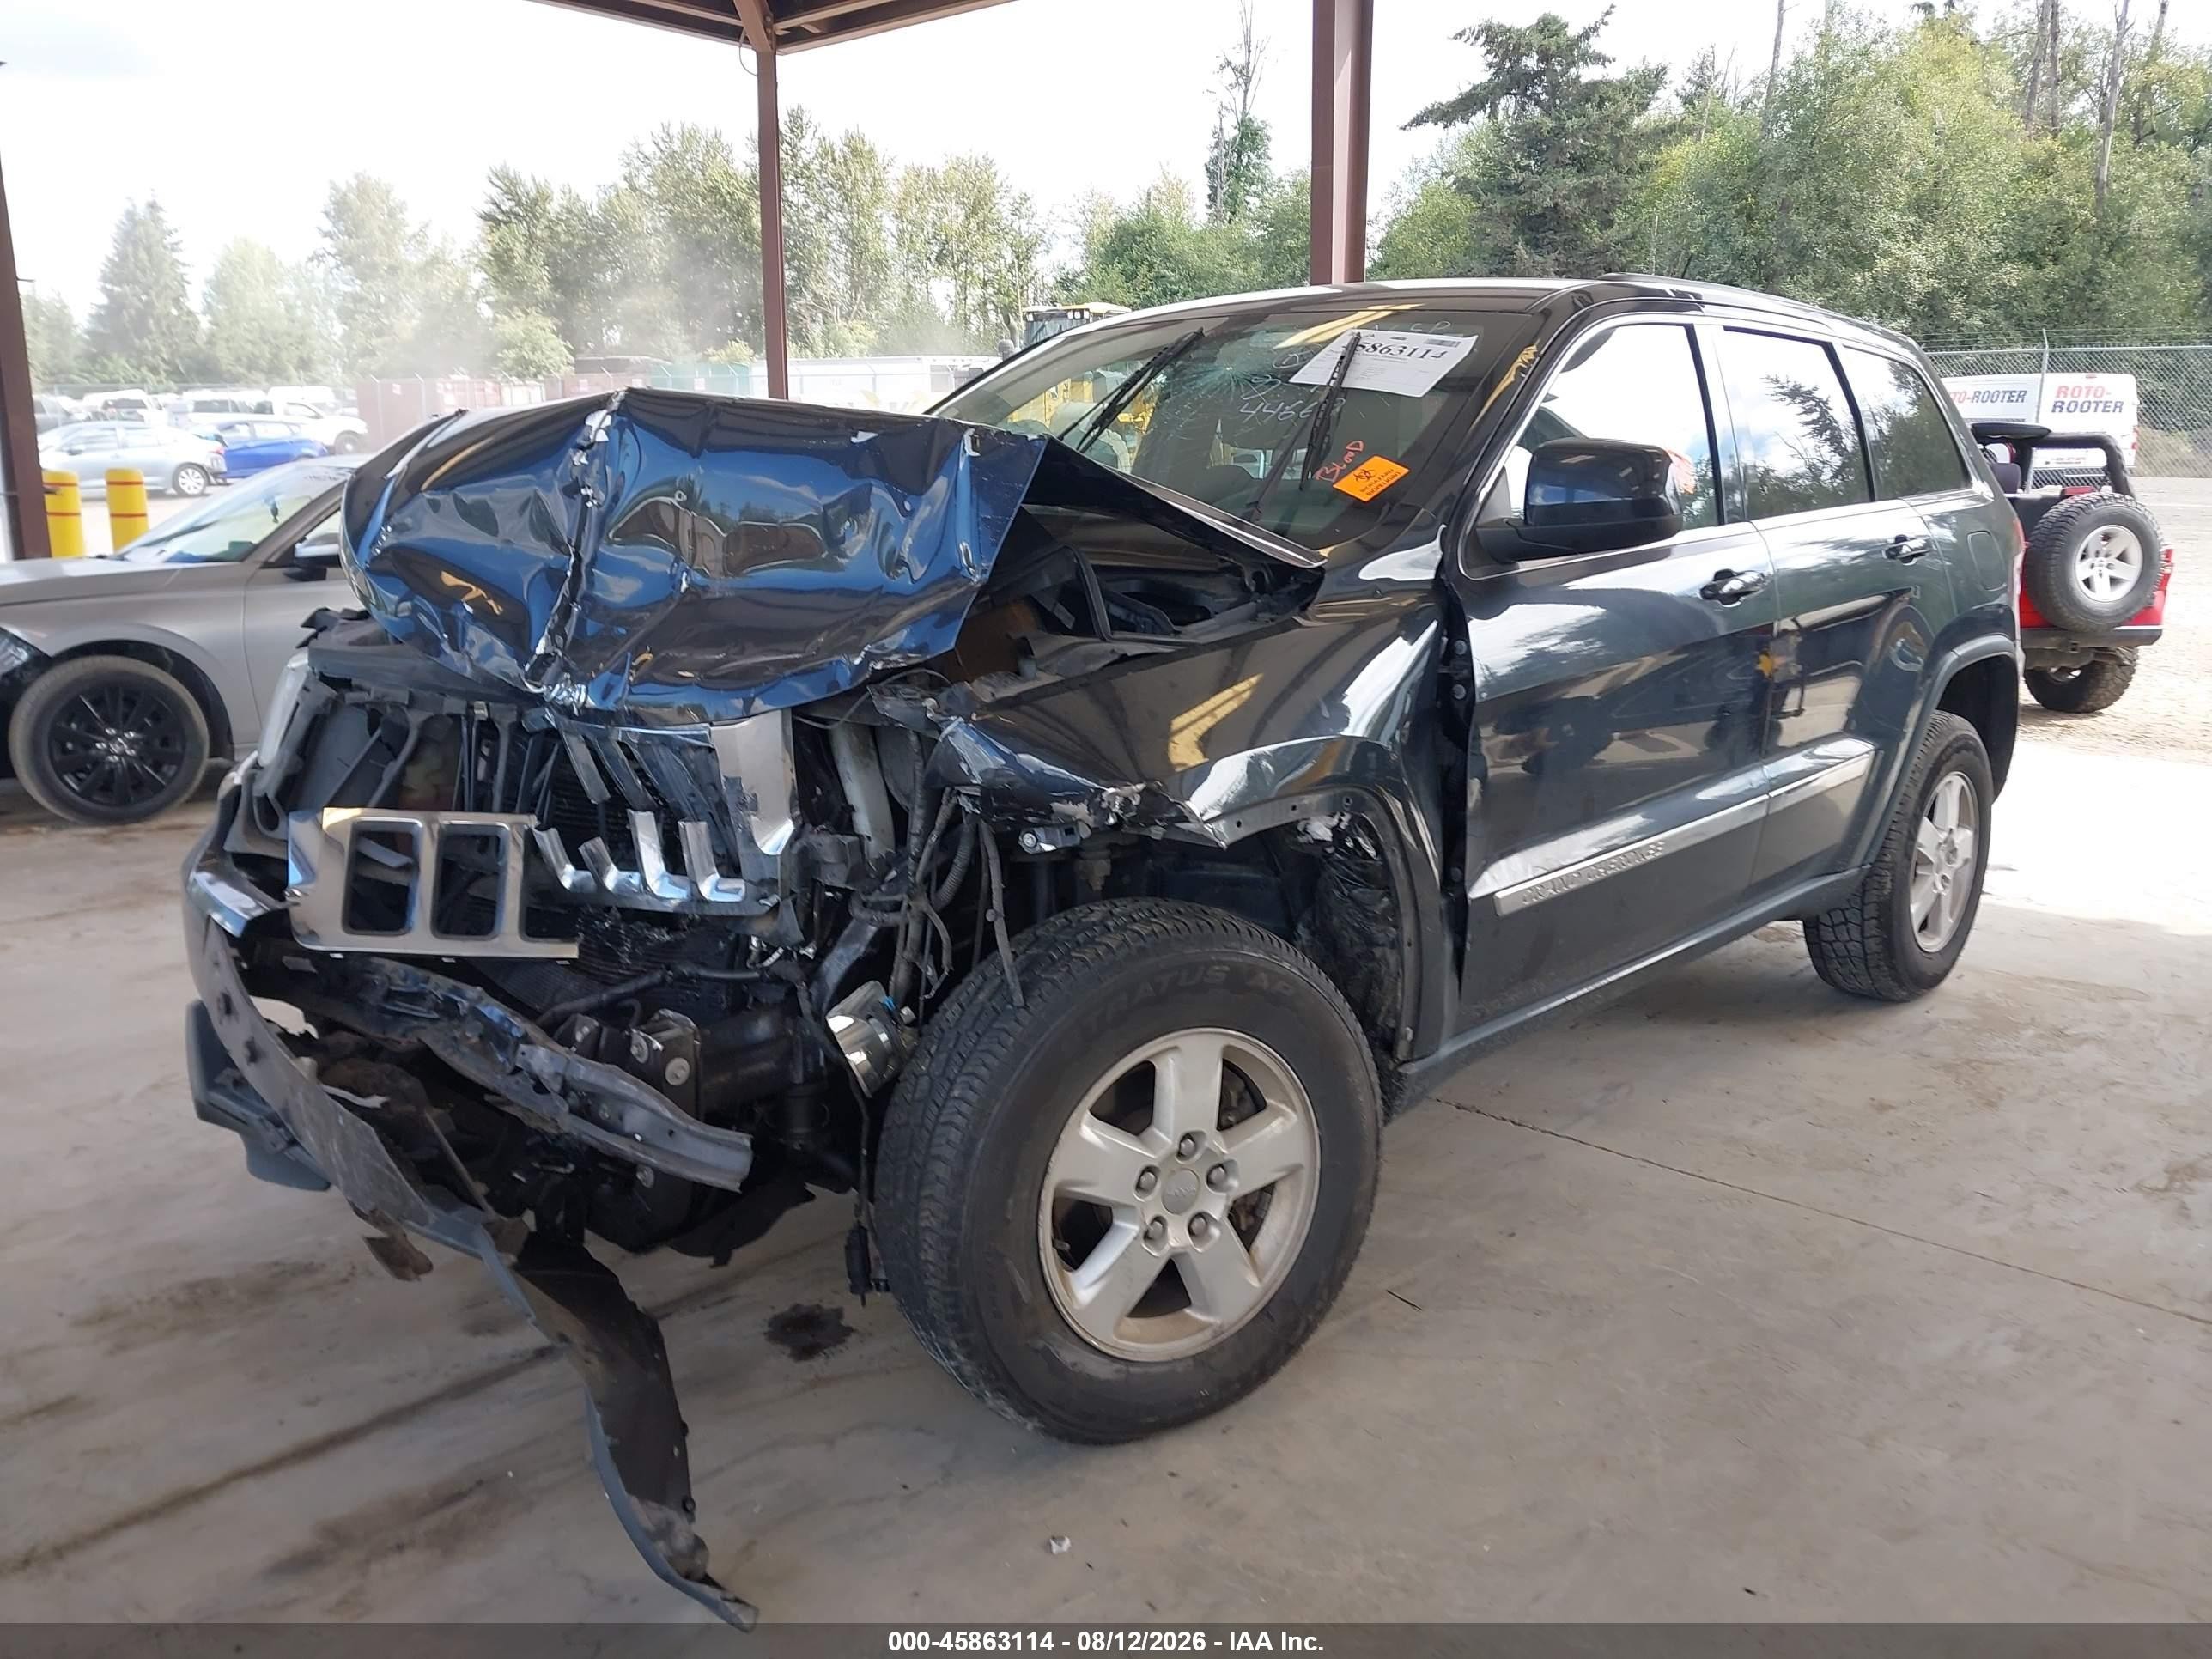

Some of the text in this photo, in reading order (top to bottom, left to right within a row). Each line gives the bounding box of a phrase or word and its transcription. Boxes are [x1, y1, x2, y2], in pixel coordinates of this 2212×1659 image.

[1341, 342, 1449, 358] 5863114
[1948, 390, 2027, 404] TO-ROOTER
[2055, 386, 2112, 398] ROTO-
[2051, 400, 2124, 413] ROOTER
